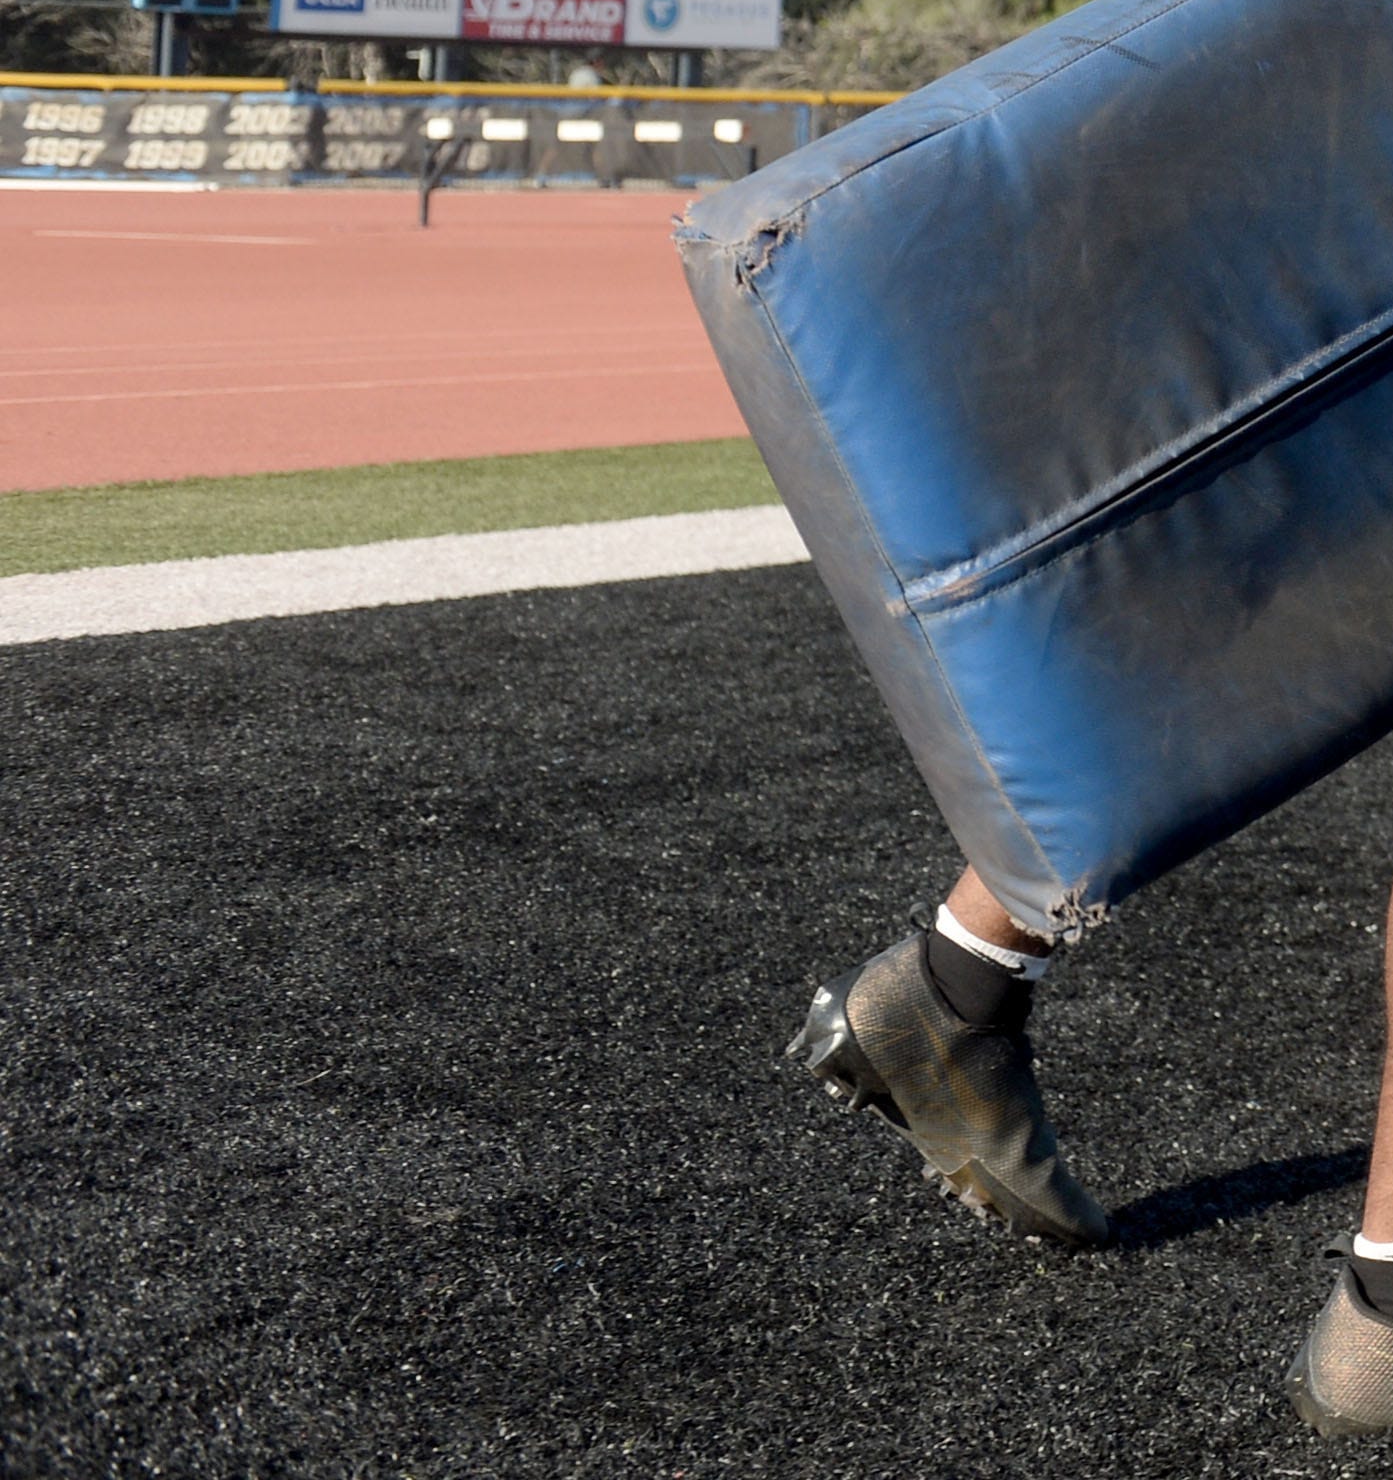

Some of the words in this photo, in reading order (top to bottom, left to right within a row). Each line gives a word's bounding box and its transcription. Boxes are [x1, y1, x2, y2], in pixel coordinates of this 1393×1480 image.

[22, 102, 106, 134] 1996
[126, 104, 210, 135] 1998
[21, 136, 107, 167] 1997
[123, 139, 209, 170] 1999
